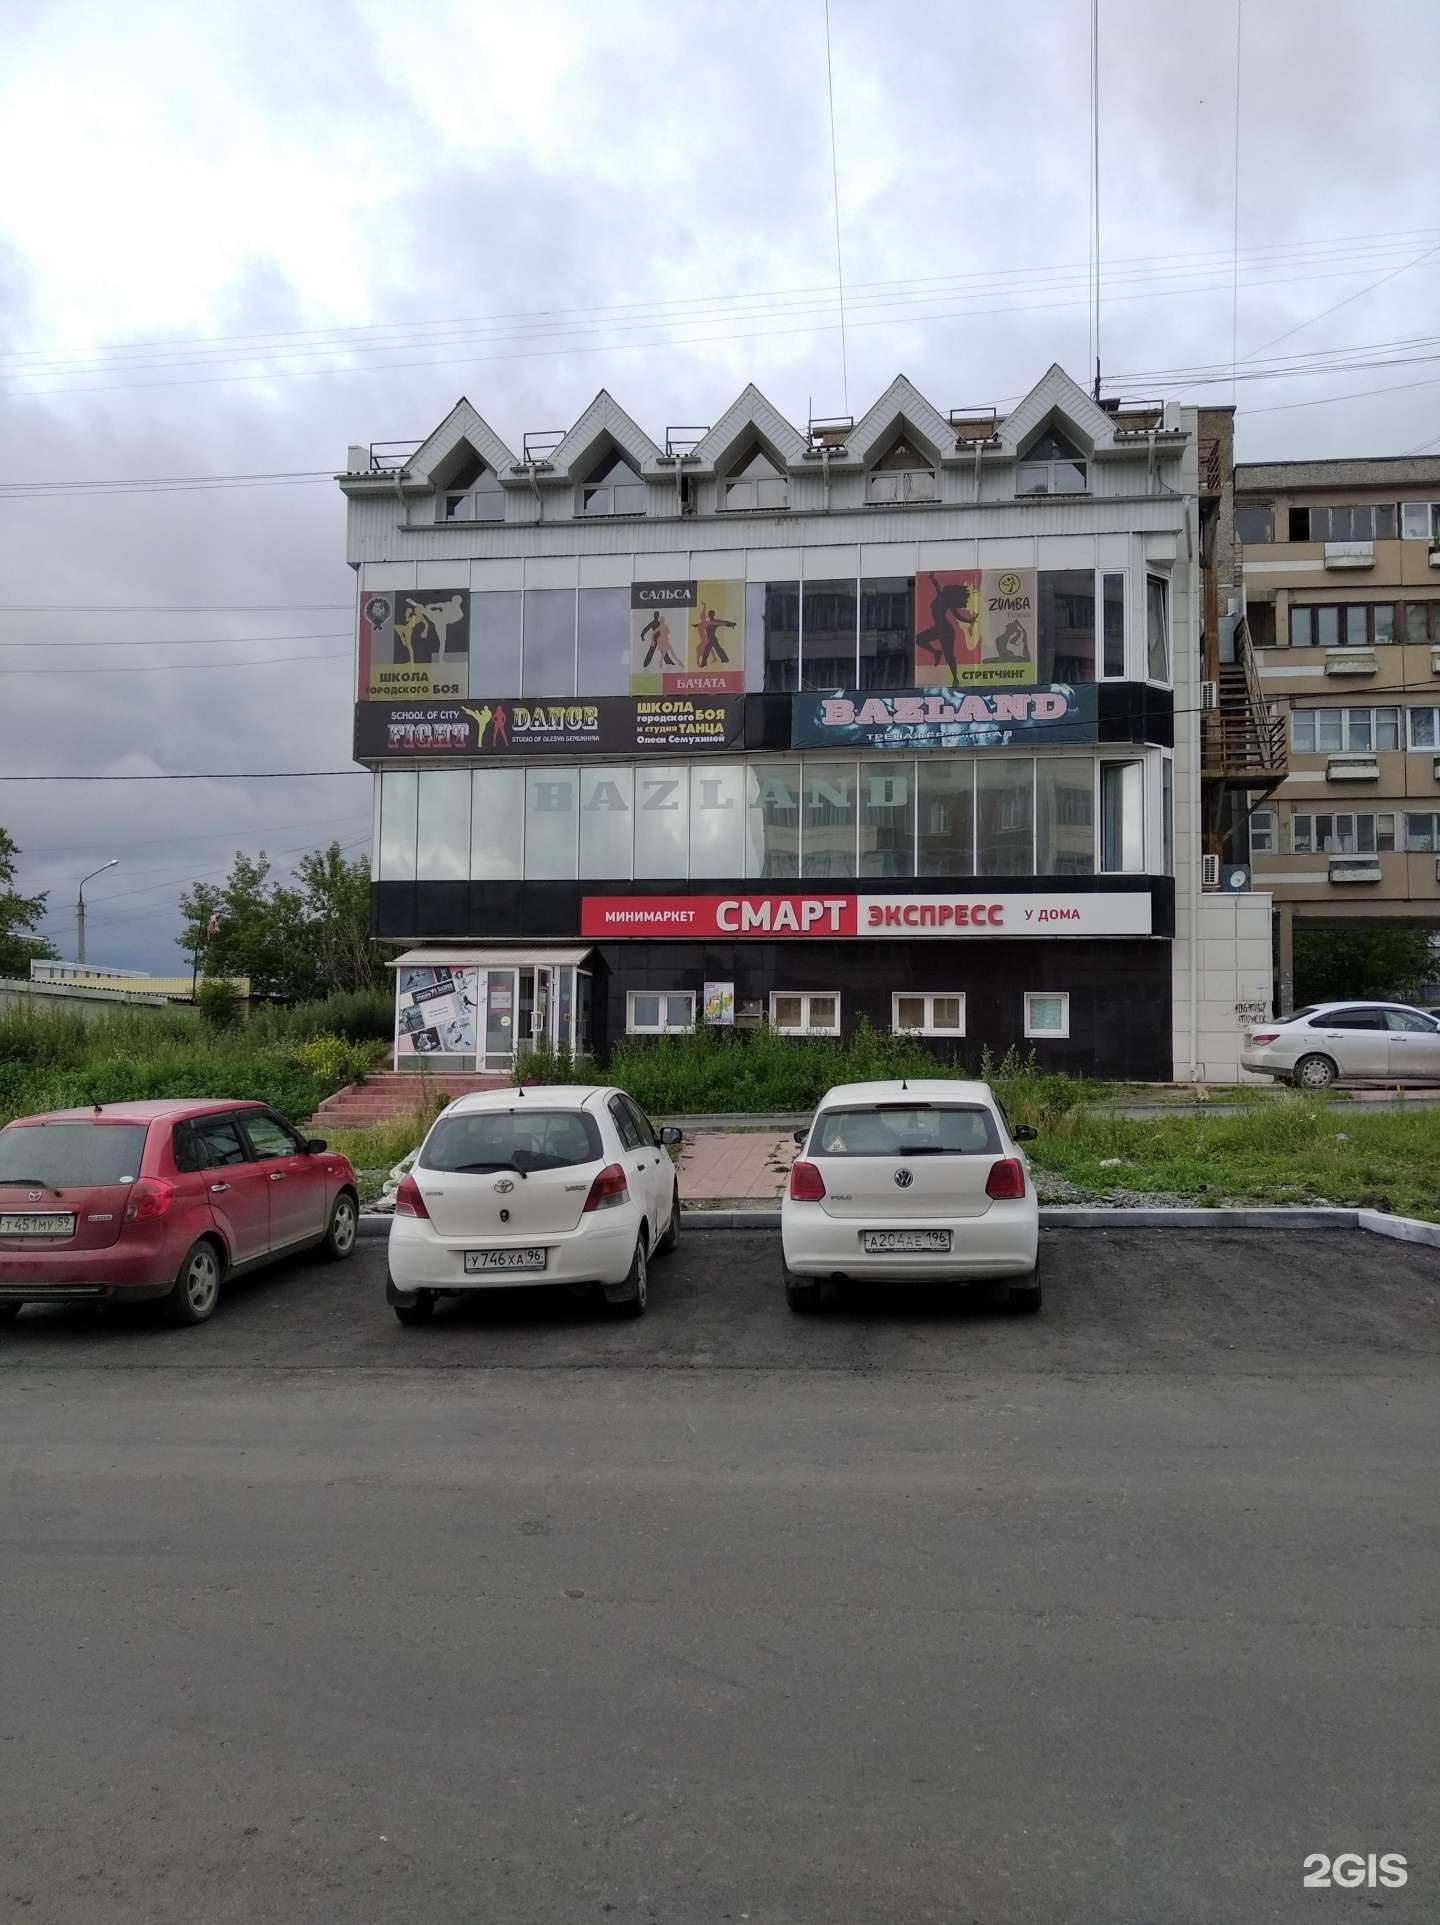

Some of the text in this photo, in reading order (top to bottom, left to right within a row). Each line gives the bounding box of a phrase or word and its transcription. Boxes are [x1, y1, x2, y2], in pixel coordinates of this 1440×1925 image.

[639, 589, 692, 600] САЛЬСА
[988, 597, 1031, 611] ZUMBA
[379, 672, 429, 682] ШКОЛА
[961, 669, 1025, 680] СТРЕТЧИНГ
[432, 684, 459, 694] БОЯ
[676, 678, 727, 689] БАЧАТА
[636, 702, 694, 713] ШКОЛА
[821, 693, 1067, 725] BAZLAND
[391, 710, 460, 720] SCHOOL OF CITY
[512, 706, 598, 731] DANCE
[637, 709, 725, 724] городского БОЯ
[387, 722, 470, 748] FIGHT
[679, 722, 725, 735] ТАНЦА
[533, 775, 909, 812] BAZLAND
[605, 900, 1081, 932] МИНИМАРКЕТ СМАРТ ЭКСПРЕСС У ДОМА
